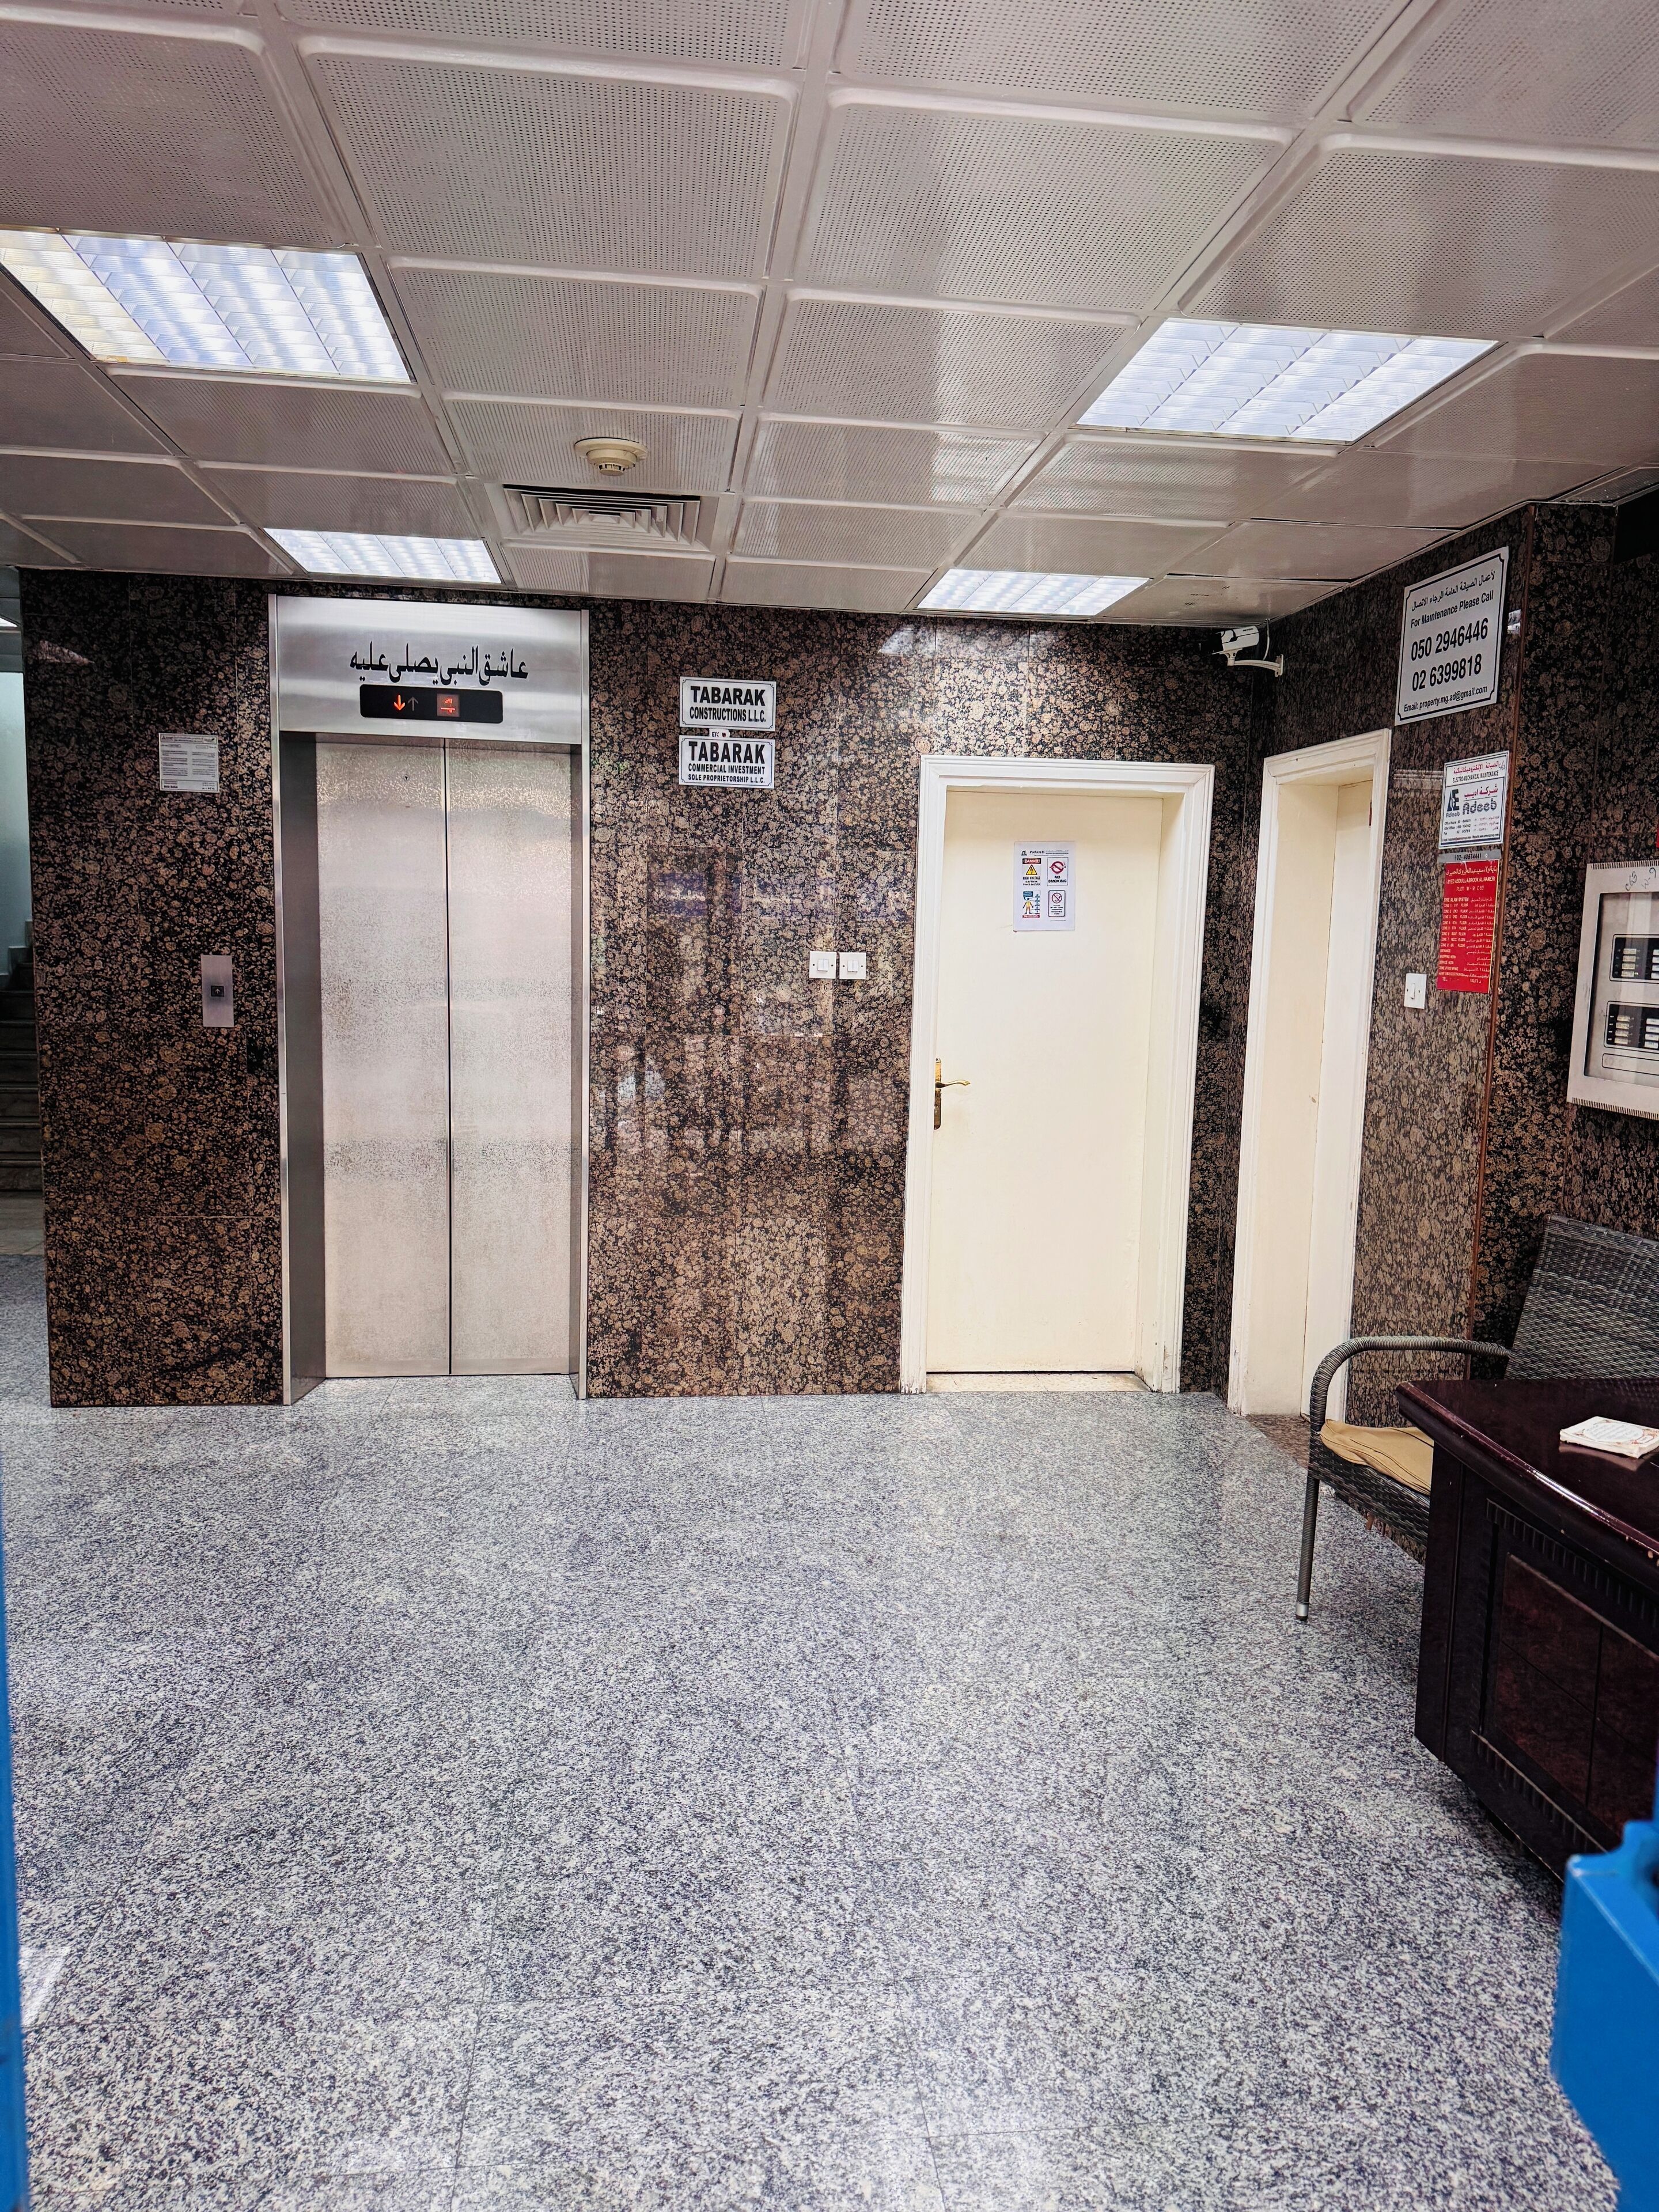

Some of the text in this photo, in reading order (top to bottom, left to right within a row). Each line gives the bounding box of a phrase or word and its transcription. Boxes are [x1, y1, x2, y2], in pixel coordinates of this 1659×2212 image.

[1411, 589, 1494, 628] For Maintenance Please Call
[1411, 618, 1488, 661] 050 2946446
[350, 641, 389, 681] عليه
[479, 647, 529, 686] عاشق
[1412, 653, 1482, 691] 02 6399818
[690, 685, 766, 706] TABARAK
[1404, 684, 1487, 713] Email: property.mg.ad@gmail.com
[690, 706, 766, 722] CONSTRUCTIONS L.L.C.
[689, 741, 765, 764] TABARAK
[688, 763, 765, 775] COMMERCIAL INVESTMENT
[1480, 770, 1499, 778] MAINTENANCE
[1479, 783, 1498, 796] شركة
[1462, 798, 1497, 815] Adeeb
